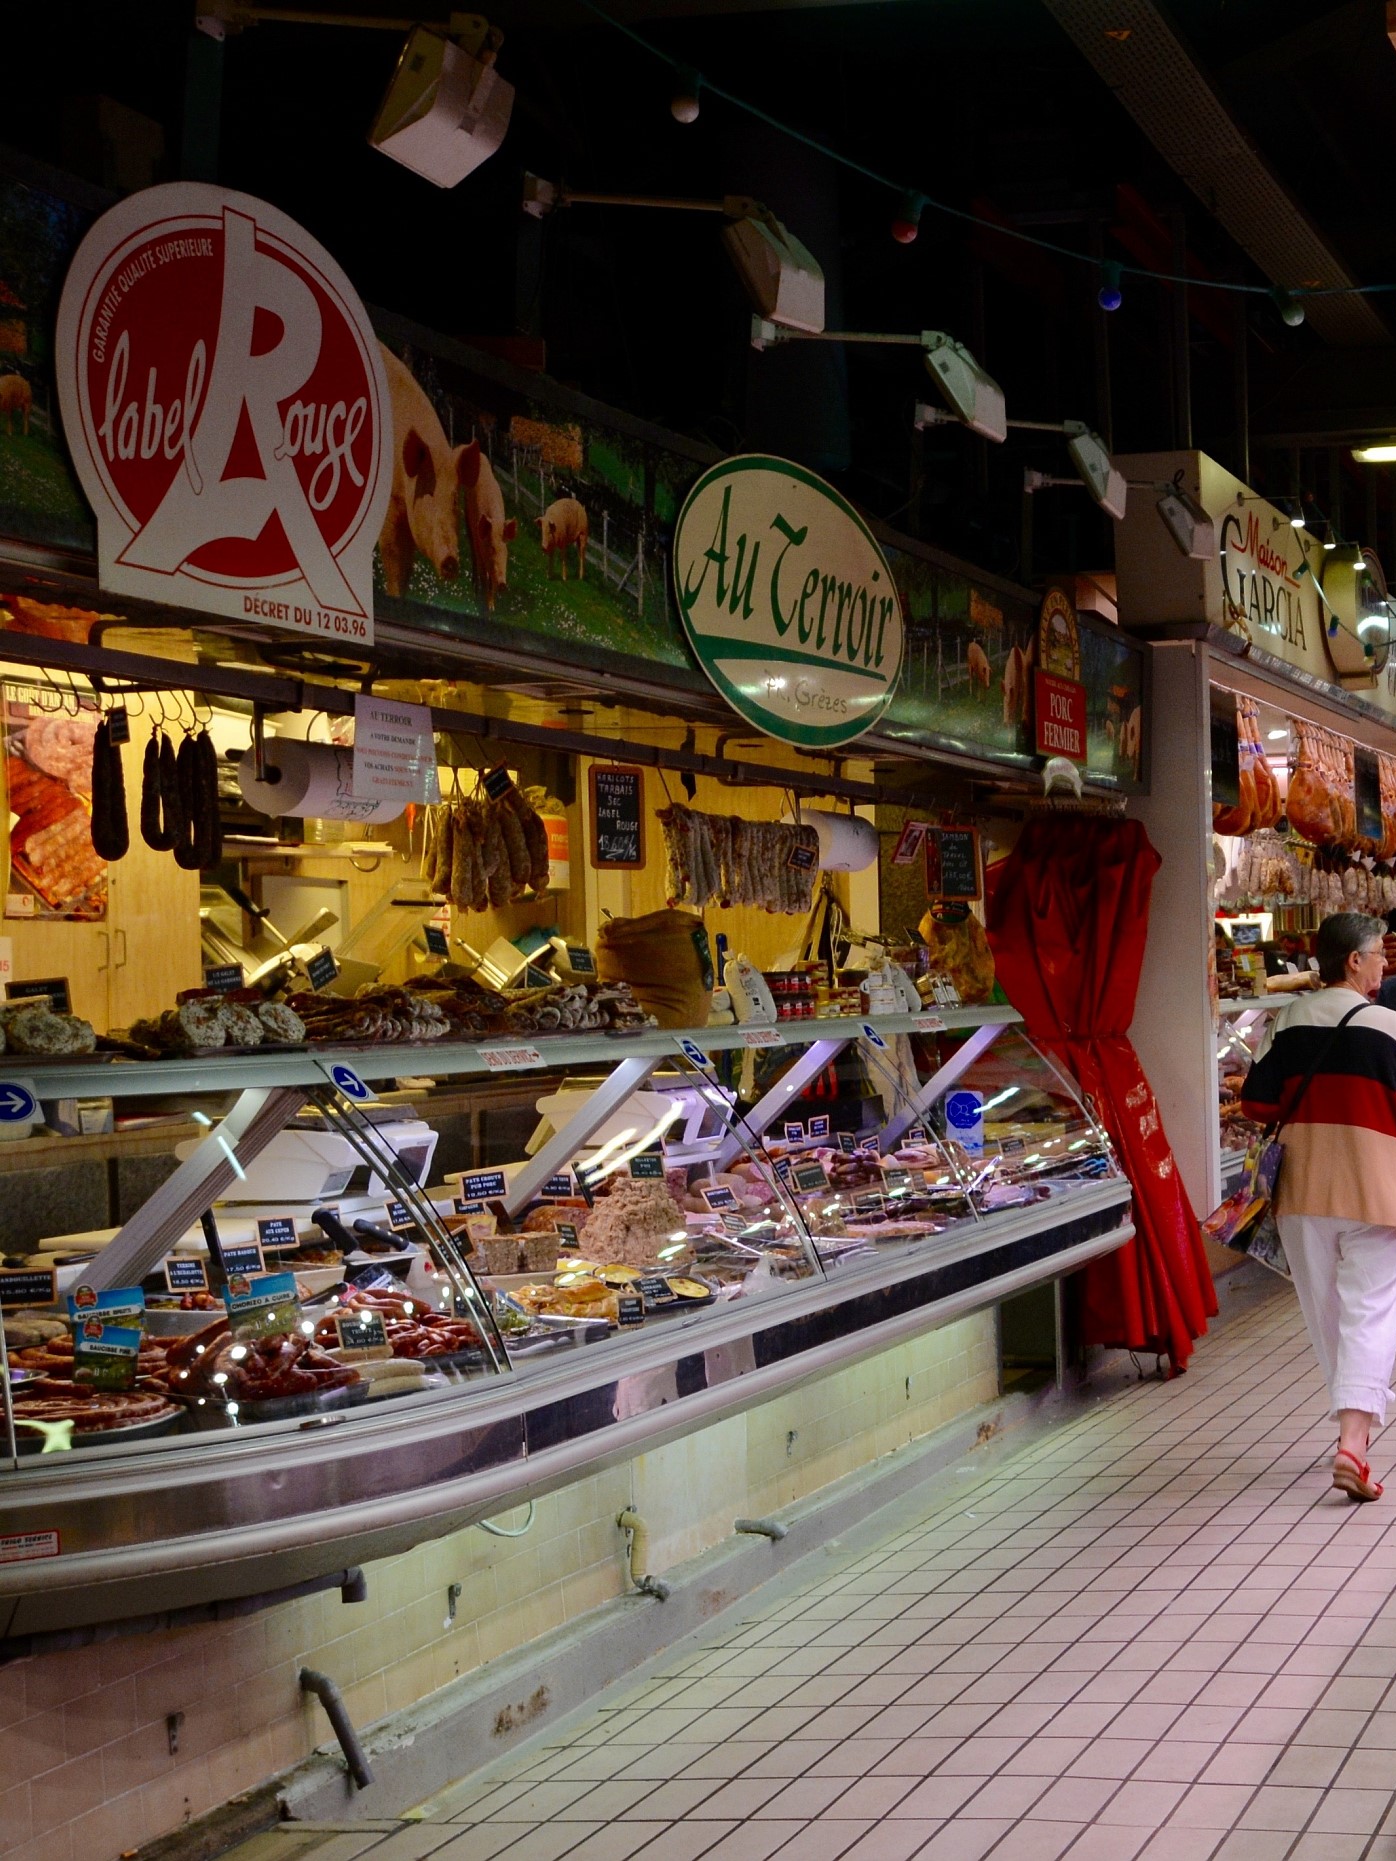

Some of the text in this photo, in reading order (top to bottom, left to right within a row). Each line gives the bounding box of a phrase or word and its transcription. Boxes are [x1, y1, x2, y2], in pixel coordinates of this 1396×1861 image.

[93, 285, 122, 363] GARANTIE
[98, 330, 206, 497] label
[684, 484, 760, 620] Au
[769, 513, 894, 669] Terroir
[1220, 514, 1307, 651] GARCIA
[1231, 511, 1294, 583] Maison
[244, 592, 290, 620] DÉCRET
[294, 607, 312, 625] DU
[1043, 721, 1081, 753] FERMIER
[1050, 692, 1073, 723] PORC
